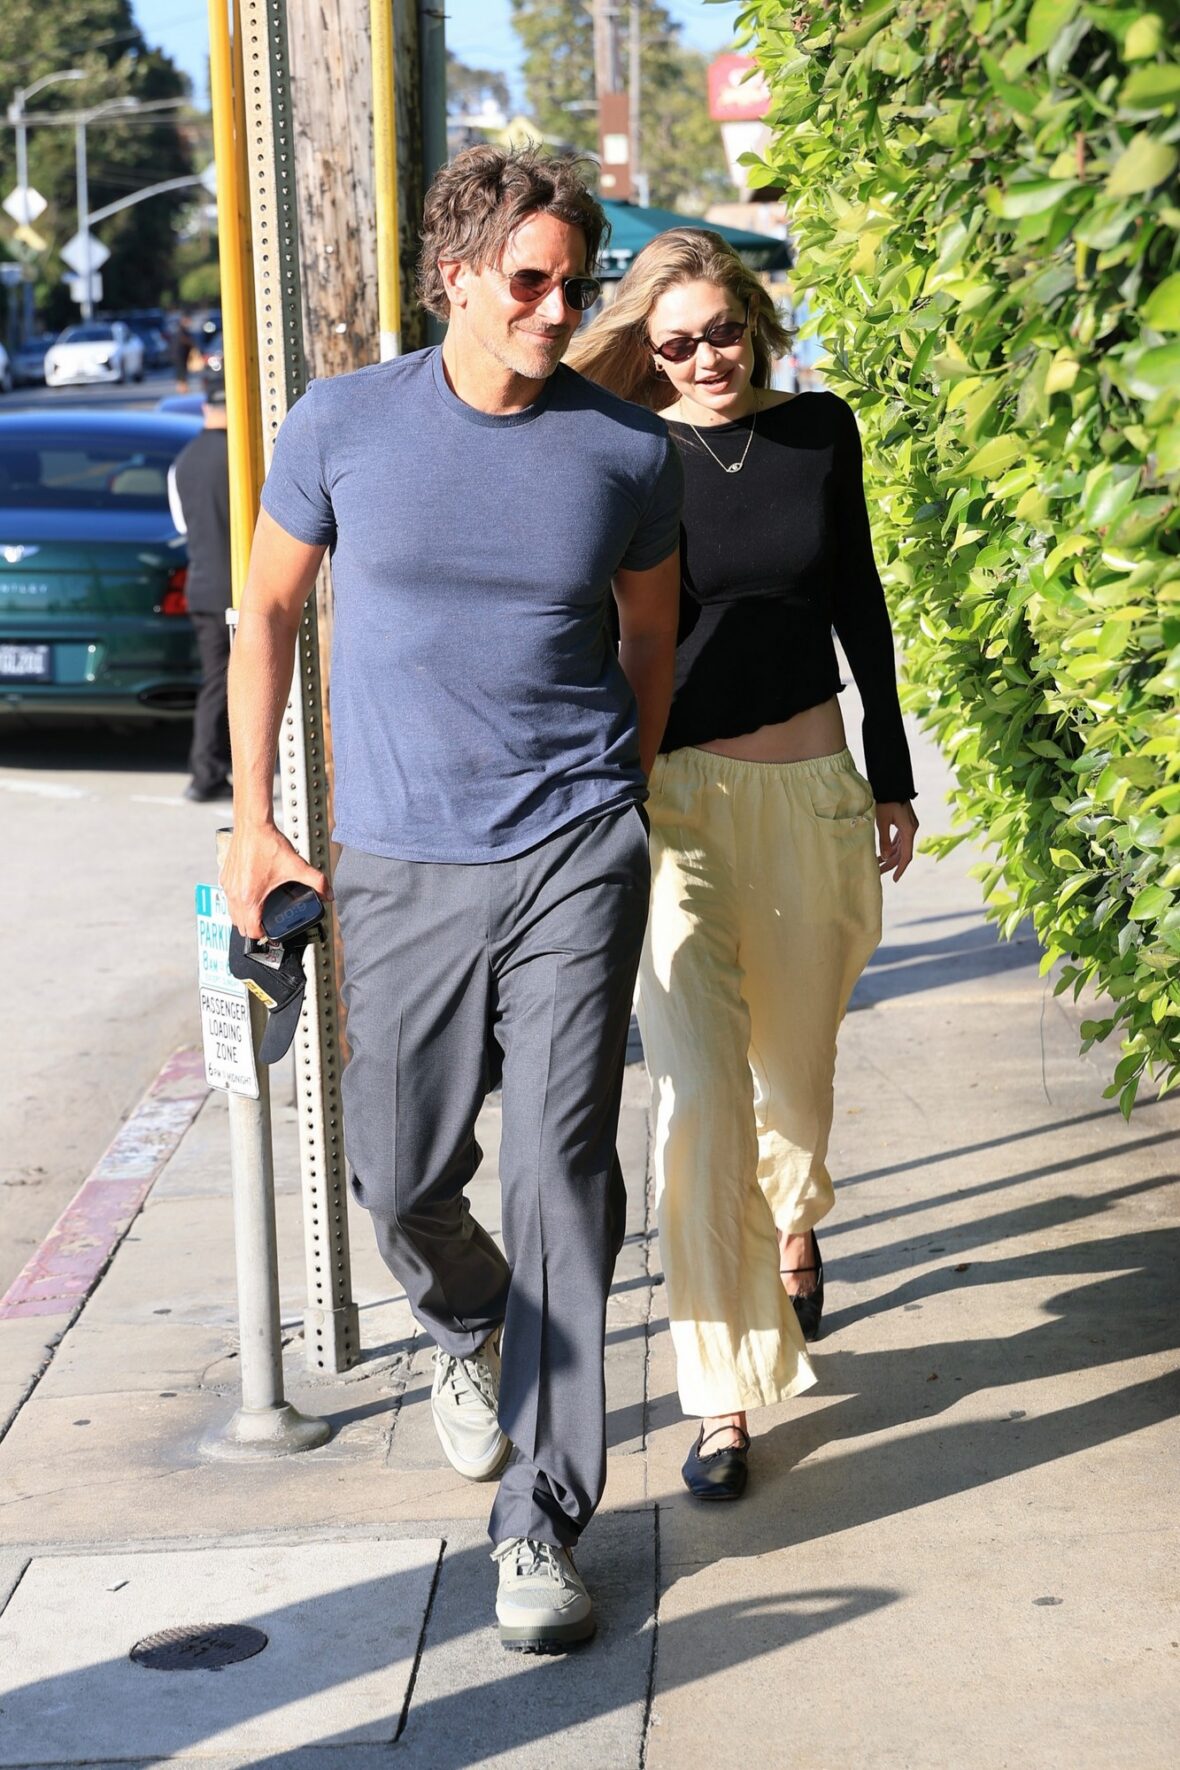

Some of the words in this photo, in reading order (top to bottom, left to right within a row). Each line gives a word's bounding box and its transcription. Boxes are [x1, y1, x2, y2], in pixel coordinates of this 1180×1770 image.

[201, 887, 207, 913] 1
[200, 920, 231, 952] PARKI
[202, 994, 247, 1022] PASSENGER
[208, 1018, 242, 1043] LOADING
[216, 1042, 238, 1064] ZONE
